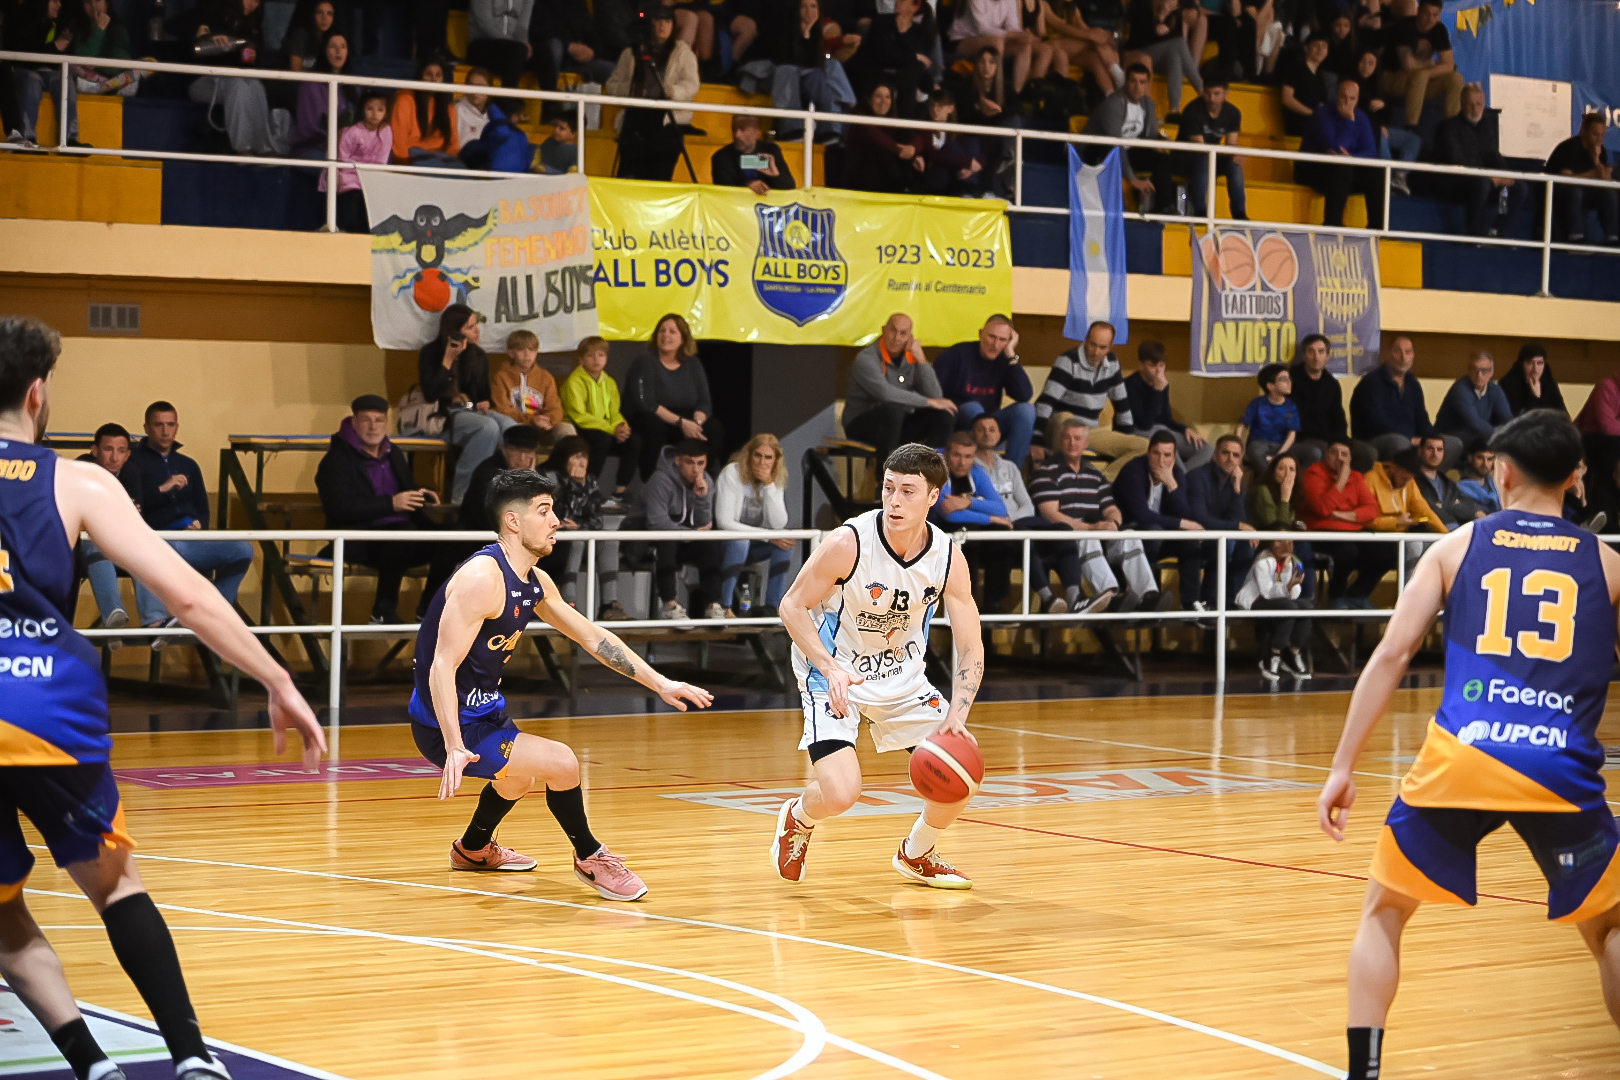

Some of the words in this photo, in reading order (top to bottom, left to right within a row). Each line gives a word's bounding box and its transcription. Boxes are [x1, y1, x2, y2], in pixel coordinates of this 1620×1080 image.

[498, 186, 587, 224] BASQUET
[876, 244, 921, 264] 1923
[946, 247, 995, 269] 2023
[593, 258, 646, 287] ALL
[655, 258, 730, 288] BOYS
[761, 261, 792, 279] ALL
[797, 263, 841, 281] BOYS
[495, 274, 538, 323] ALL
[542, 264, 596, 318] BOYS
[934, 280, 986, 295] Centenario
[1491, 529, 1580, 553] SCHWINDT
[890, 588, 910, 611] 13
[1476, 568, 1579, 663] 13
[1488, 678, 1575, 714] Faerac
[1489, 721, 1567, 749] UPCN
